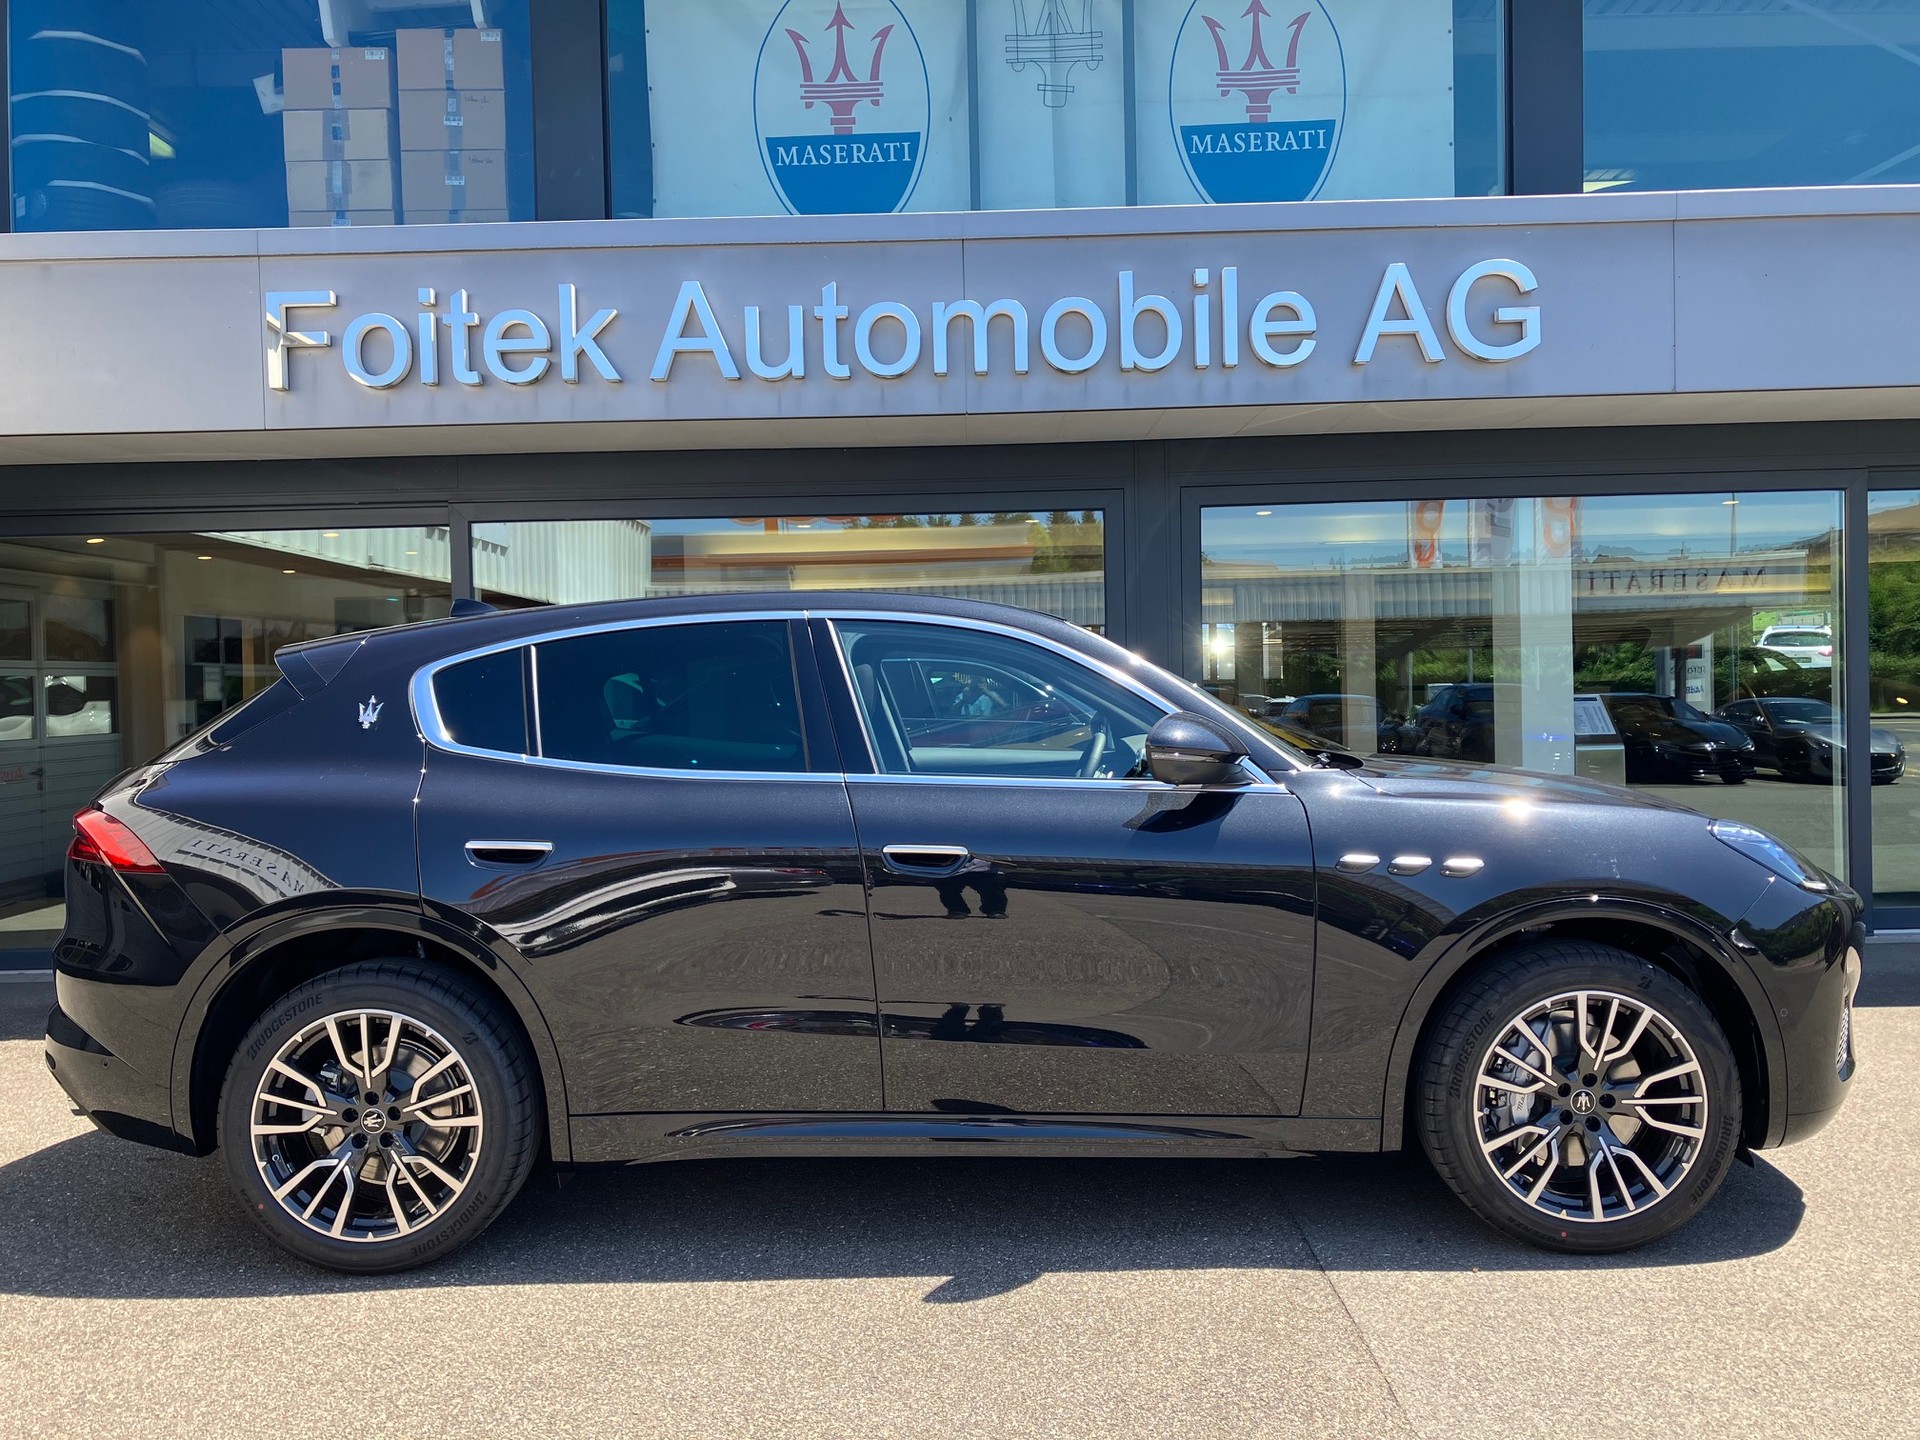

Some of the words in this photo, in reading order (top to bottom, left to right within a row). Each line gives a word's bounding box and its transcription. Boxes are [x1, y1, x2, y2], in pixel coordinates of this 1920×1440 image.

[776, 141, 912, 166] MASERATI
[1190, 129, 1327, 154] MASERATI
[266, 283, 623, 391] Foitek
[649, 266, 1317, 382] Automobile
[1352, 258, 1541, 364] AG
[247, 993, 323, 1061] BRIDGESTONE
[1449, 1009, 1496, 1100] BRIDGESTONE
[1690, 1115, 1734, 1206] BRIDGESTONE
[411, 1191, 487, 1257] BRIDGESTONE
